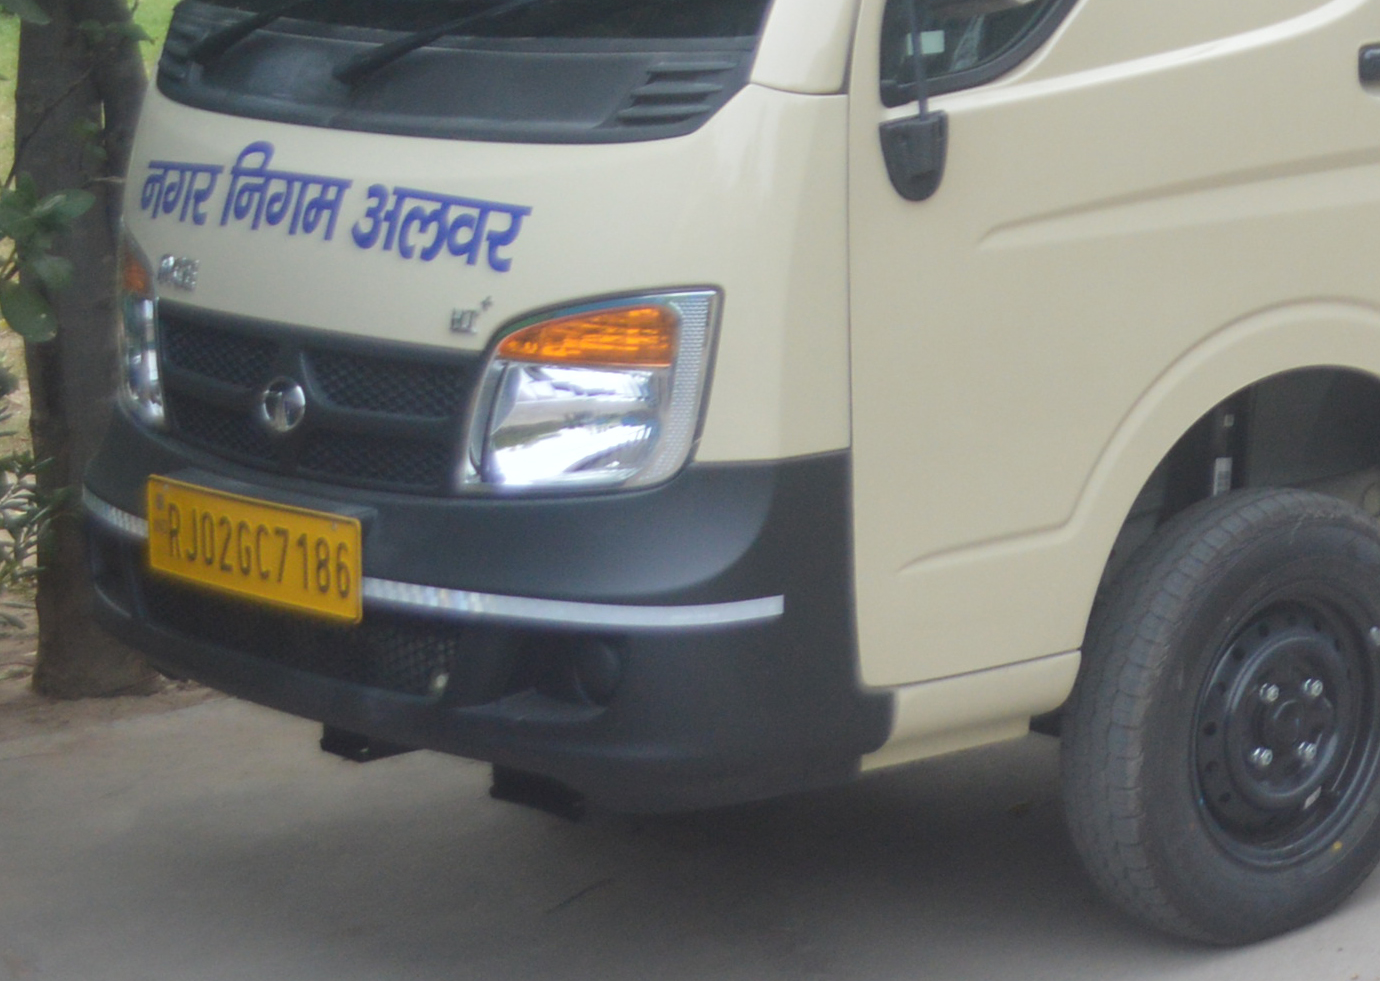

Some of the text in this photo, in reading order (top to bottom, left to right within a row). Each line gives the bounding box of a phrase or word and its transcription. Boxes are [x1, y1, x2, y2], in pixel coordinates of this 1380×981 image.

[140, 140, 533, 273] नगर निगम अलवर
[166, 501, 351, 599] RJ02GC7186
